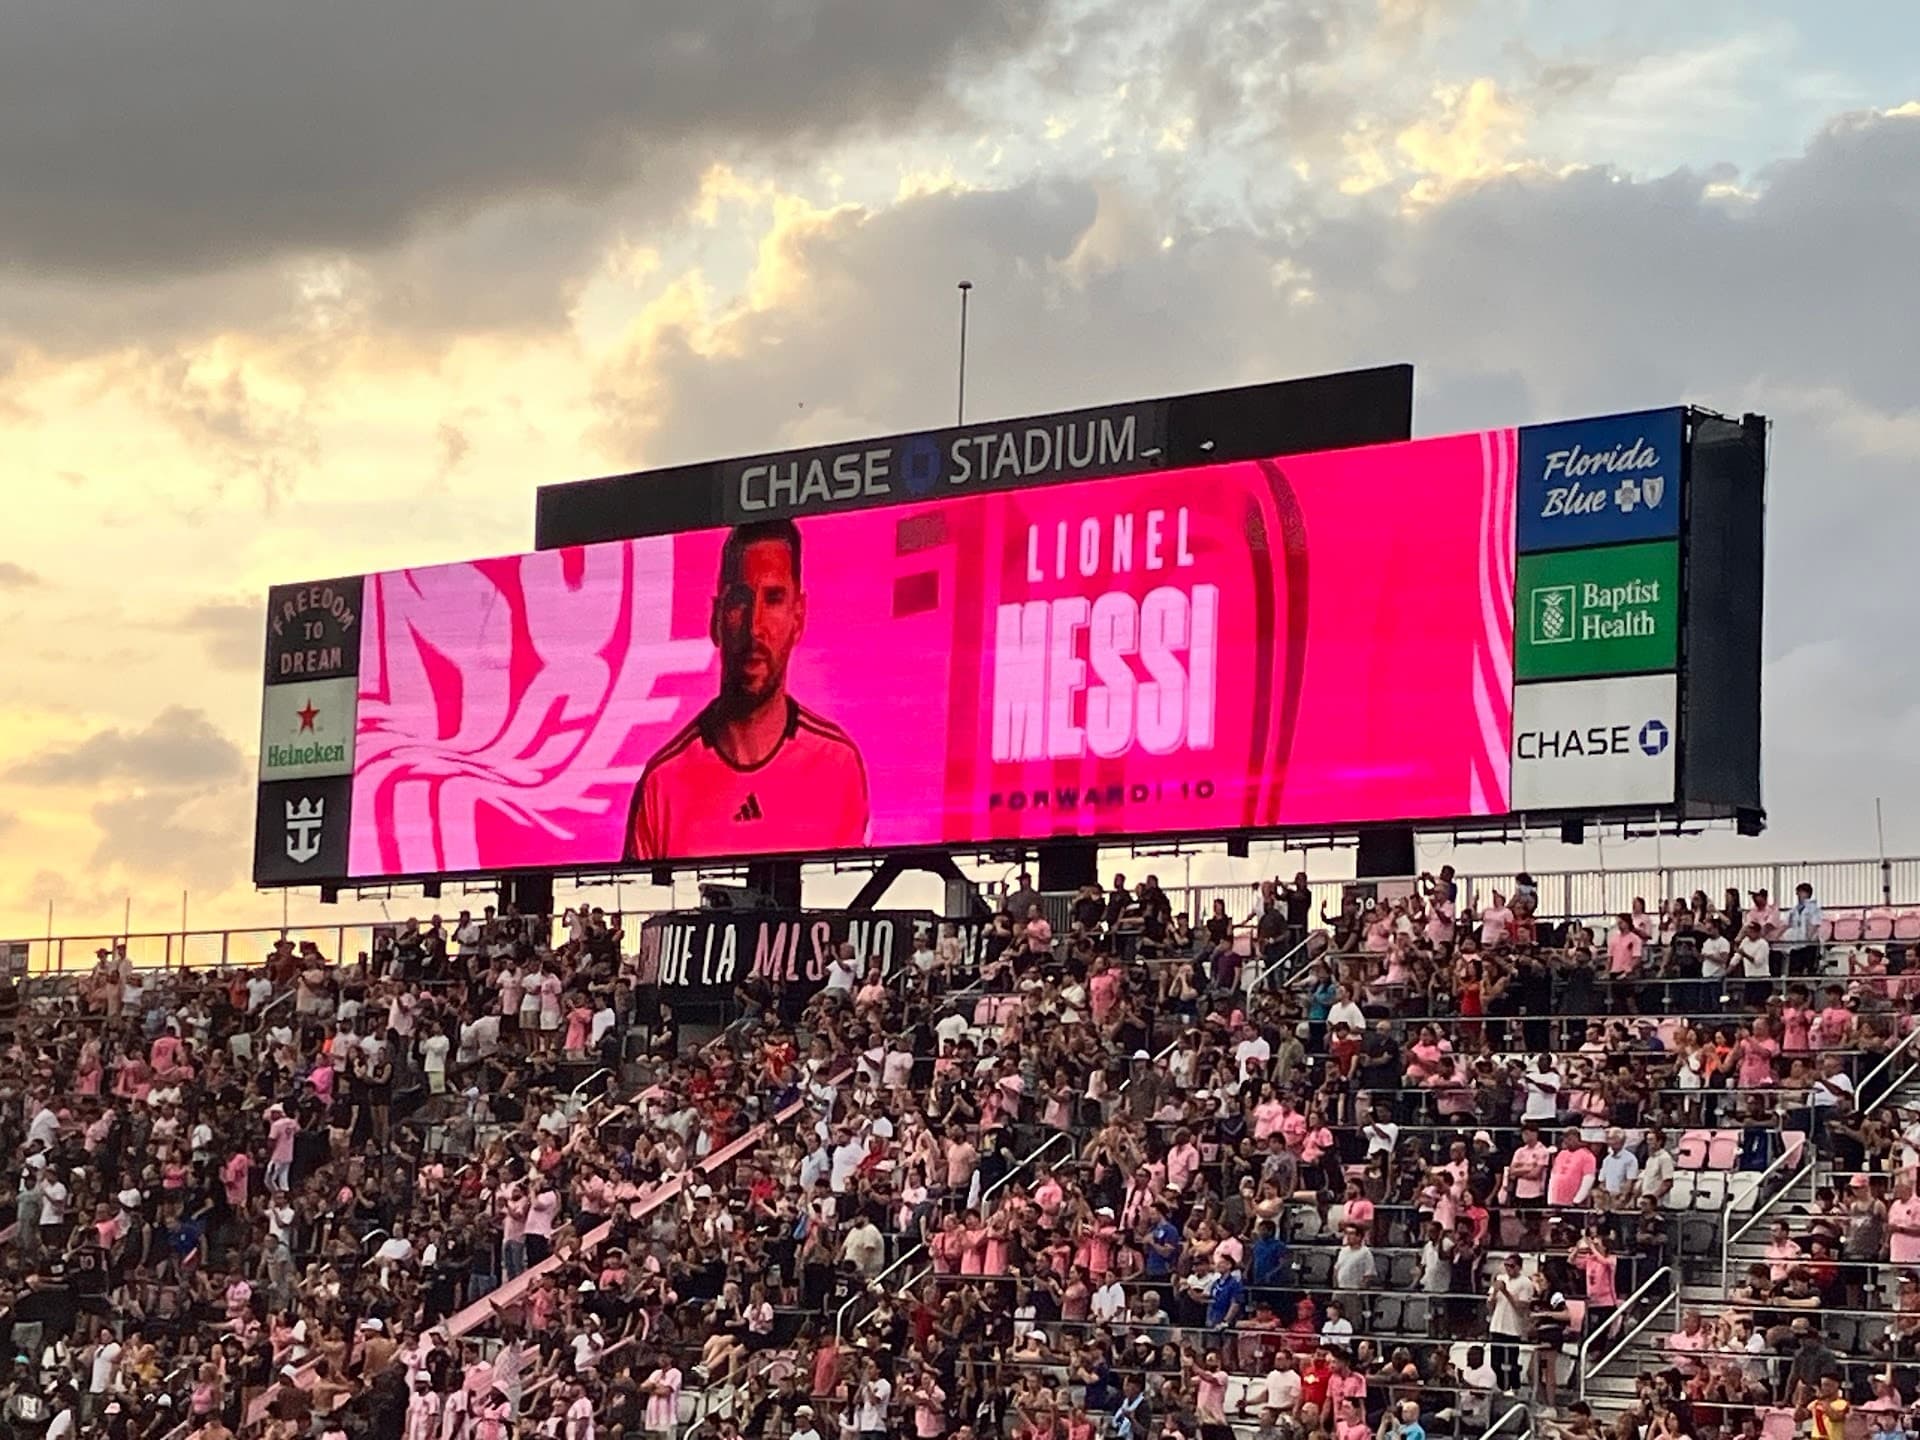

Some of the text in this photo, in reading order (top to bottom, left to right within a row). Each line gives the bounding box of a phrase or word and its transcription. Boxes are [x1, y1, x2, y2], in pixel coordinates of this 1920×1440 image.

[739, 415, 1136, 511] CHASE STADIUM
[1543, 437, 1660, 481] Florida
[1541, 482, 1607, 517] Blue
[1026, 506, 1194, 583] LIONEL
[273, 587, 355, 635] FREEDOM
[1583, 578, 1660, 613] Baptist
[303, 620, 323, 640] TO
[1582, 610, 1656, 640] Health
[280, 647, 342, 675] DREAM
[991, 583, 1219, 763] MESSI
[267, 741, 345, 767] Heineken
[1517, 724, 1632, 759] CHASE
[702, 923, 736, 984] LA
[753, 922, 830, 981] MLS
[848, 920, 893, 979] NO
